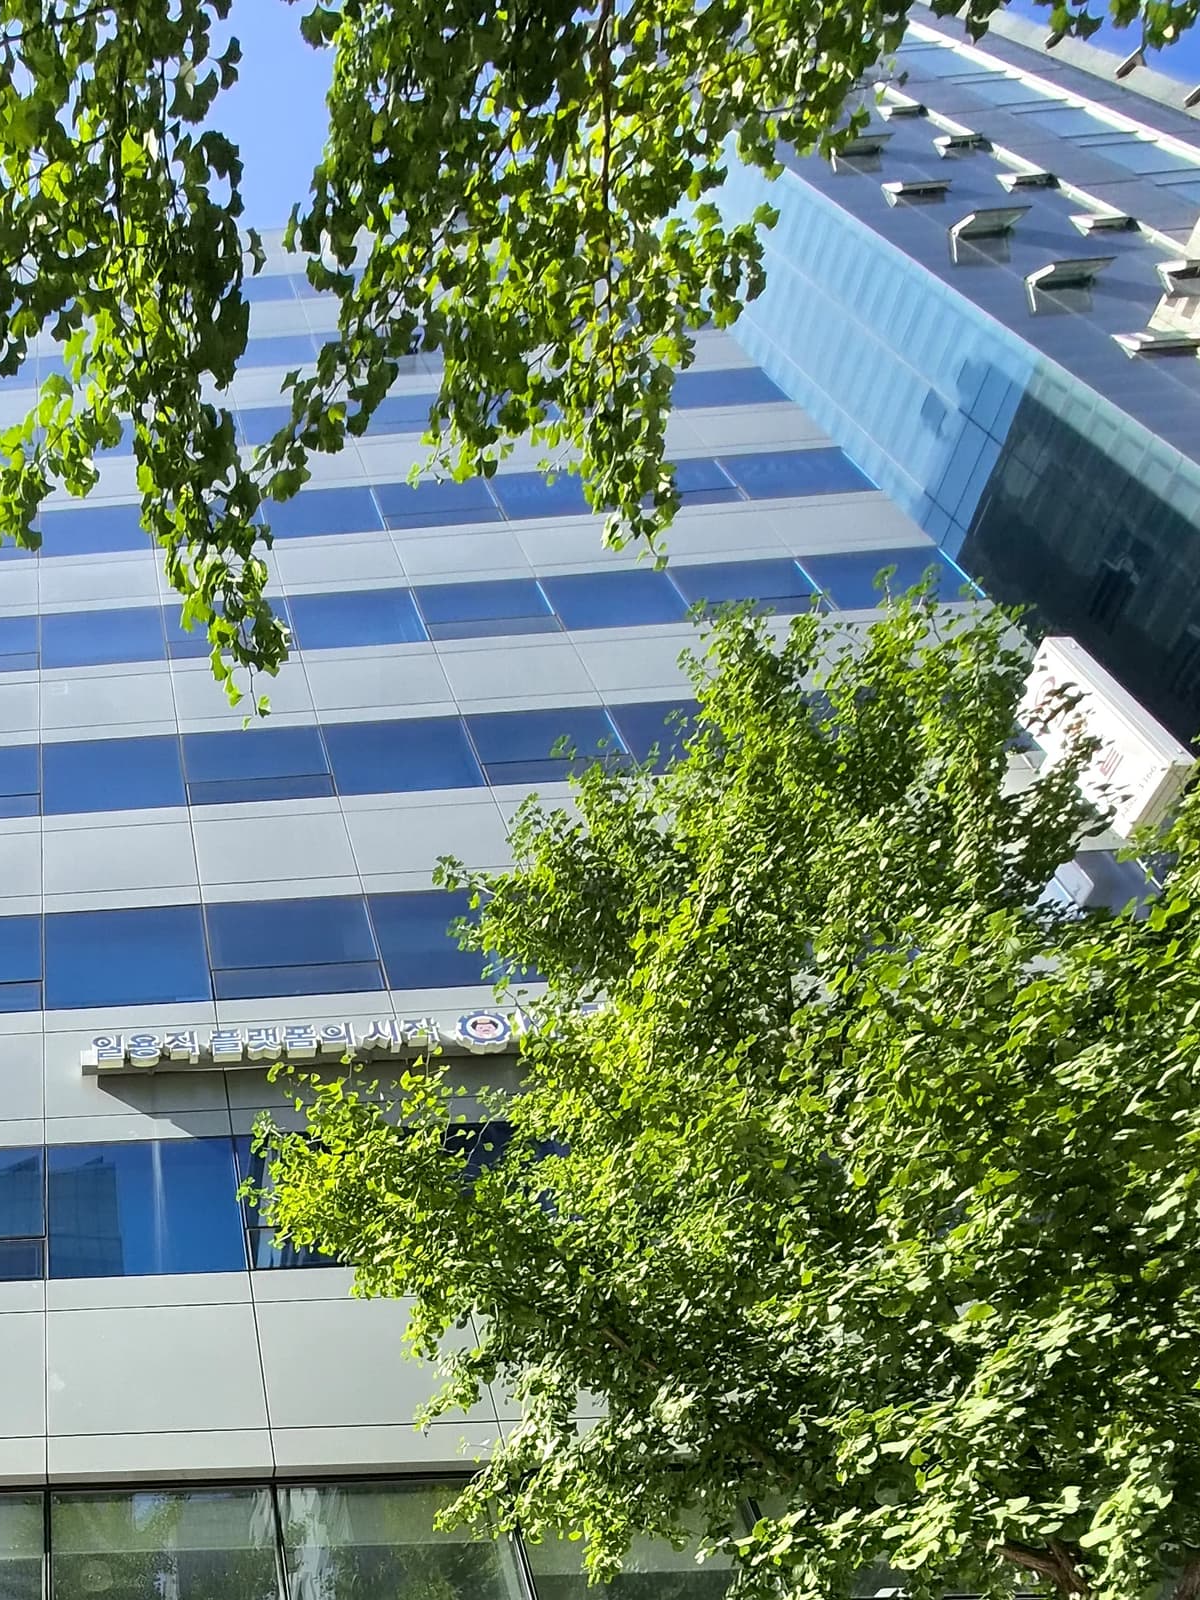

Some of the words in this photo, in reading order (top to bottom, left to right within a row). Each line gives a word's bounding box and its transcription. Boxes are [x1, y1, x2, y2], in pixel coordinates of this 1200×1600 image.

[91, 1030, 200, 1066] 일용직
[208, 1021, 357, 1061] 플랫폼의
[361, 1016, 441, 1053] 시작
